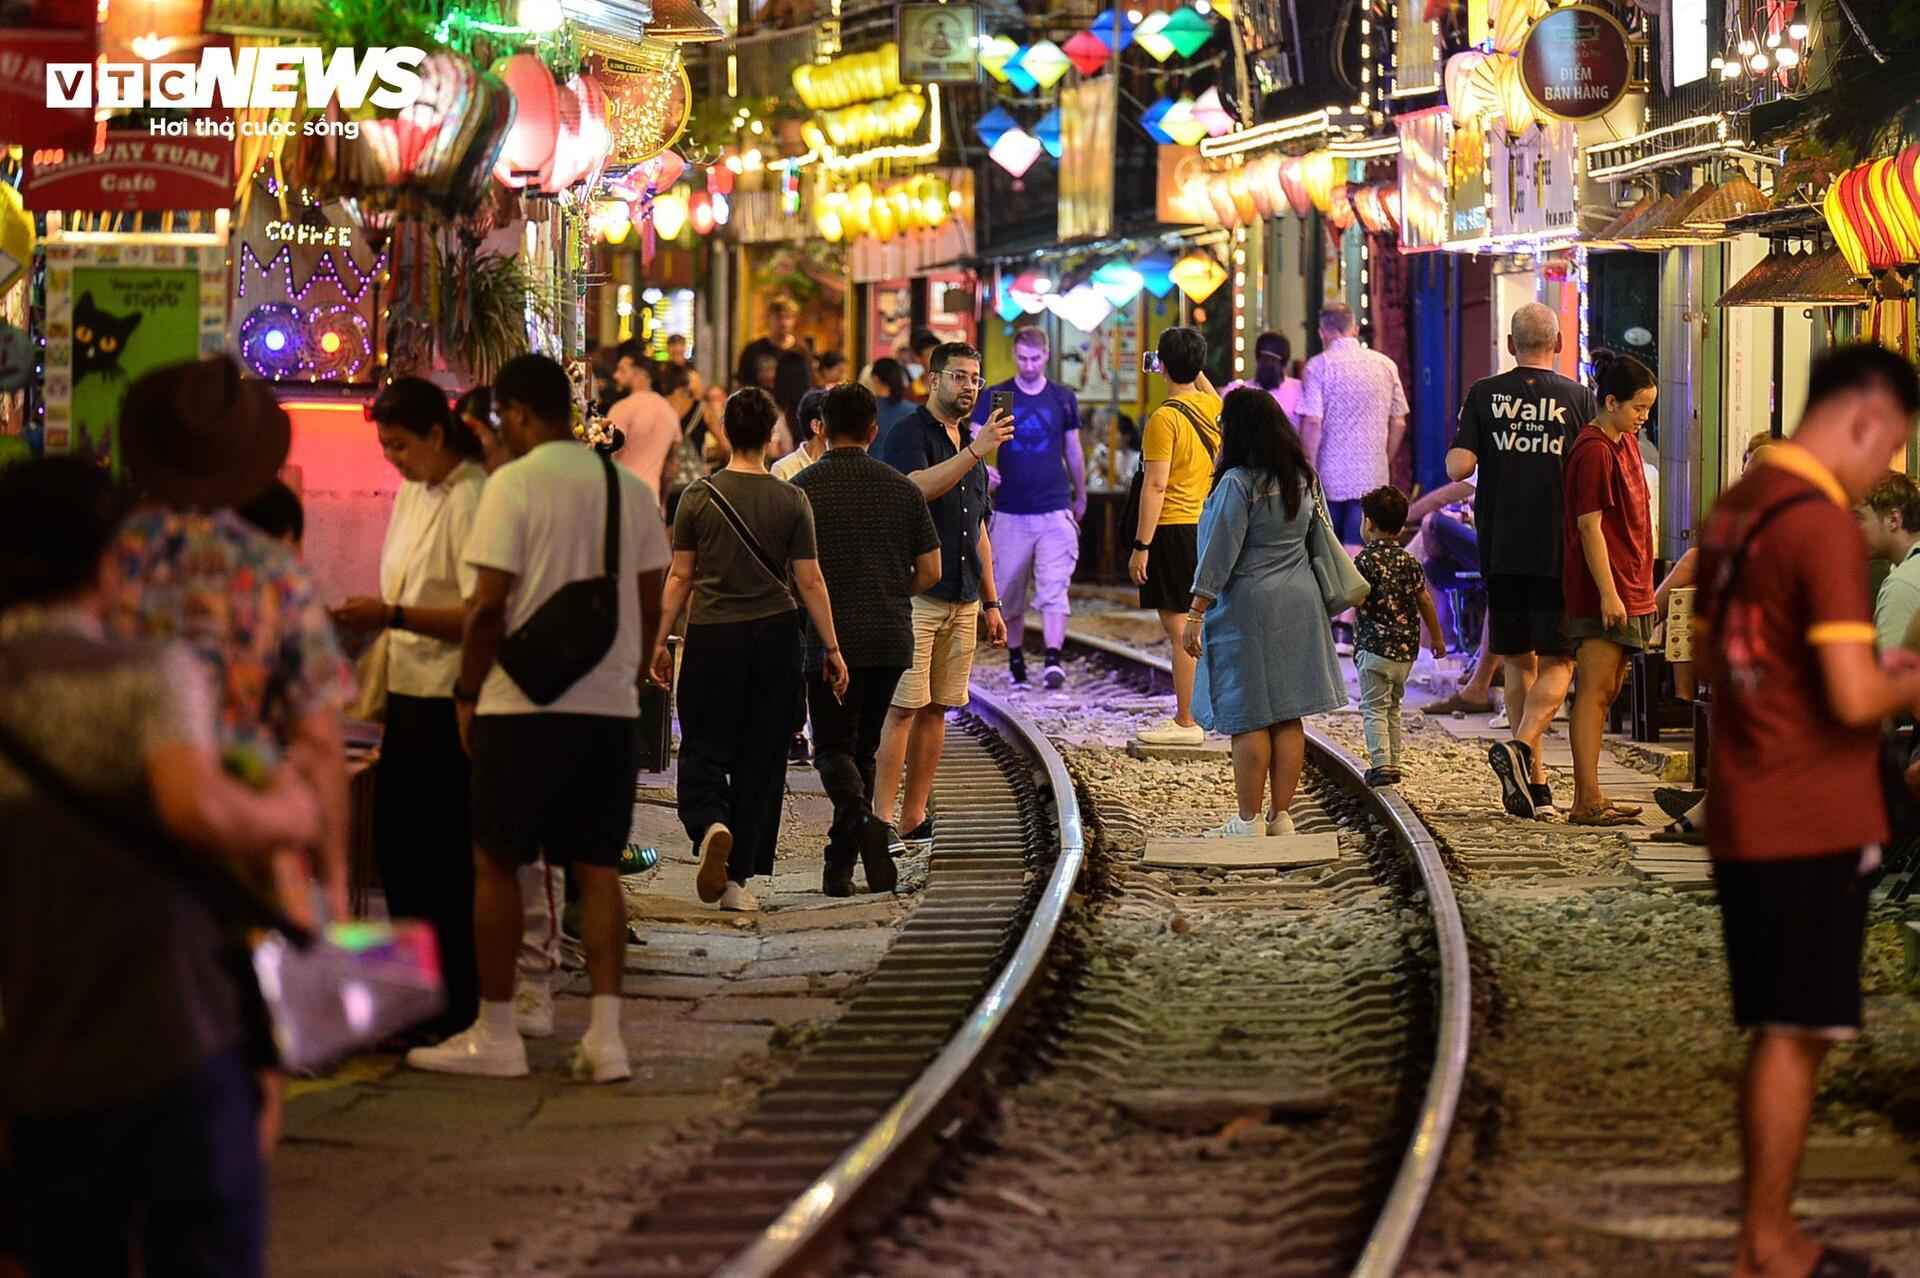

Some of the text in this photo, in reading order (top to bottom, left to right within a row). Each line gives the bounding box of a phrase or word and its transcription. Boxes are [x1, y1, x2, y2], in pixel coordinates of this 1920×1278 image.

[1561, 62, 1592, 81] ĐIỂM
[1573, 83, 1609, 99] HÀNG
[152, 142, 220, 172] TUAN
[264, 219, 352, 247] COFFEE
[238, 241, 388, 303] MAY
[1491, 393, 1512, 402] The
[1491, 398, 1567, 425] Walk
[1510, 421, 1545, 432] of the
[1491, 431, 1565, 456] World
